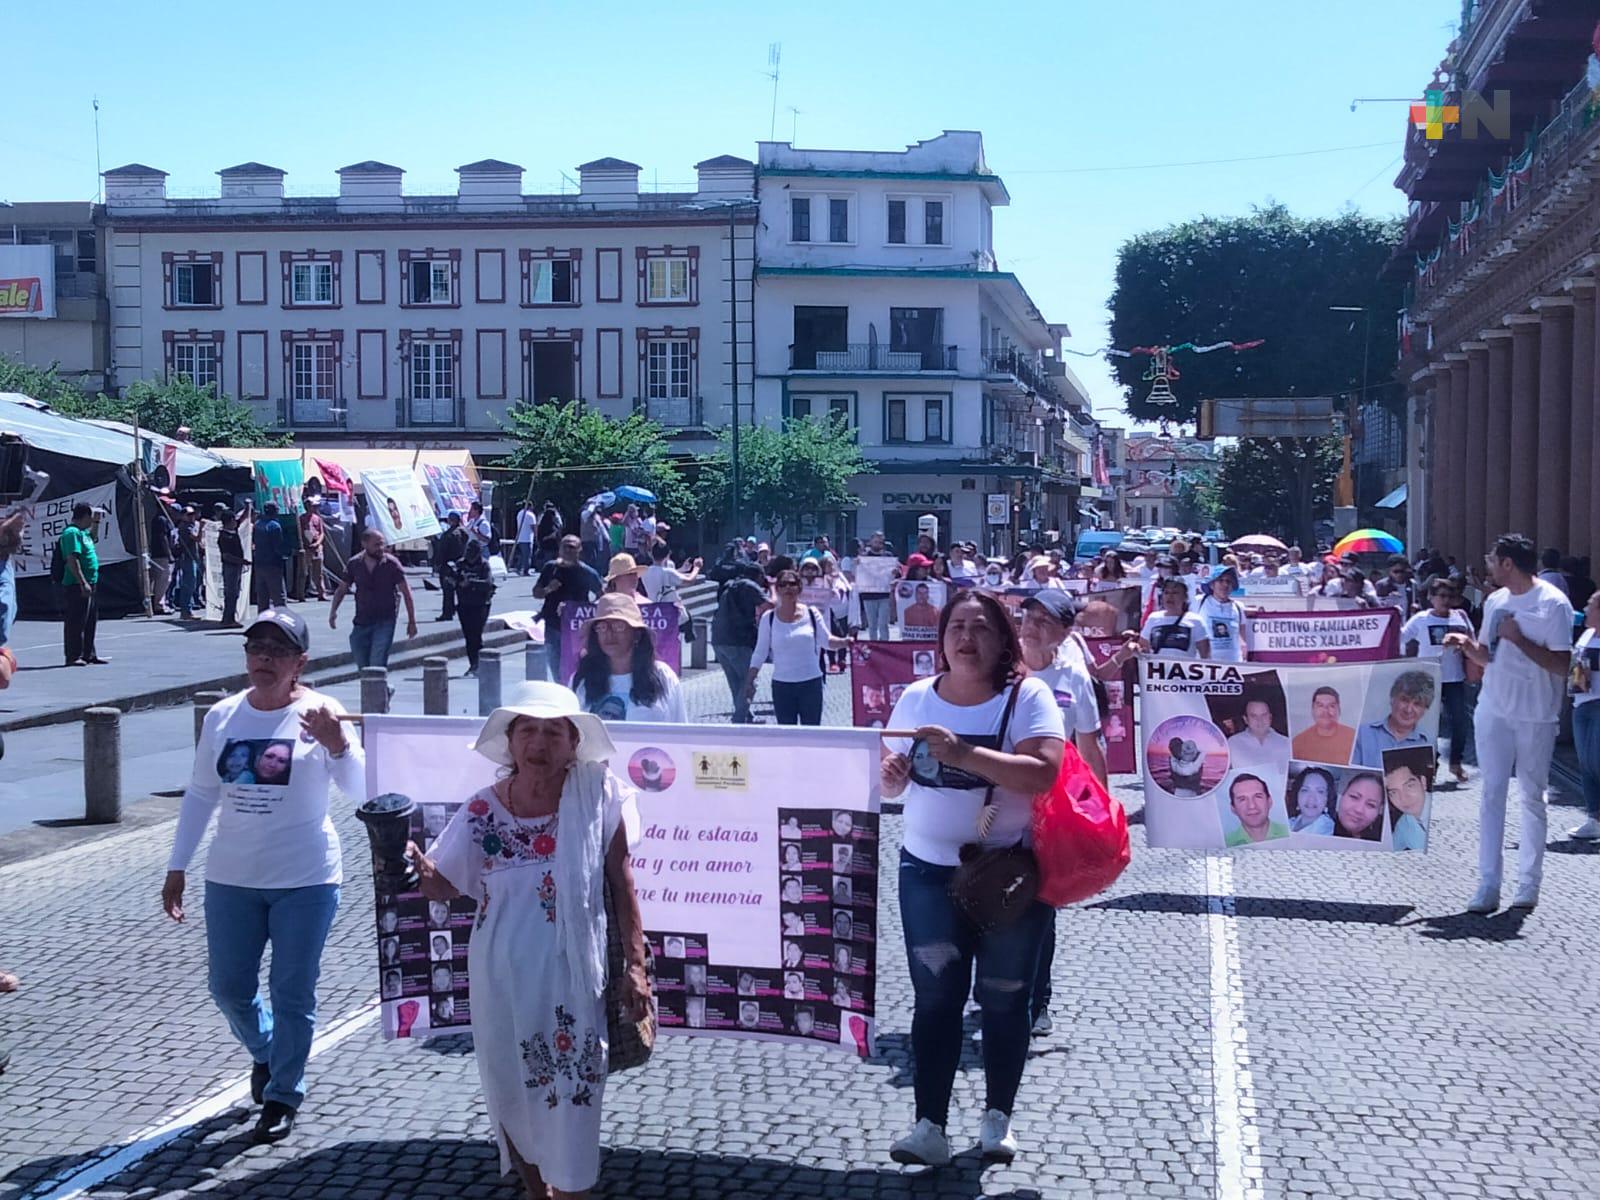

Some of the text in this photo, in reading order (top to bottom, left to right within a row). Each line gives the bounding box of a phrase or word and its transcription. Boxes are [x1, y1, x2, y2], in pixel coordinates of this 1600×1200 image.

[882, 493, 952, 505] DEVLYN
[1252, 618, 1379, 633] COLECTIVO FAMILIARES
[1269, 634, 1362, 648] ENLACES XALAPA
[1147, 661, 1242, 681] HASTA
[1146, 684, 1241, 694] ENCONTRARLES
[644, 824, 667, 841] da
[652, 858, 664, 875] y
[669, 859, 700, 873] con
[705, 859, 753, 873] amor
[662, 887, 679, 903] tu
[684, 889, 763, 905] memoria
